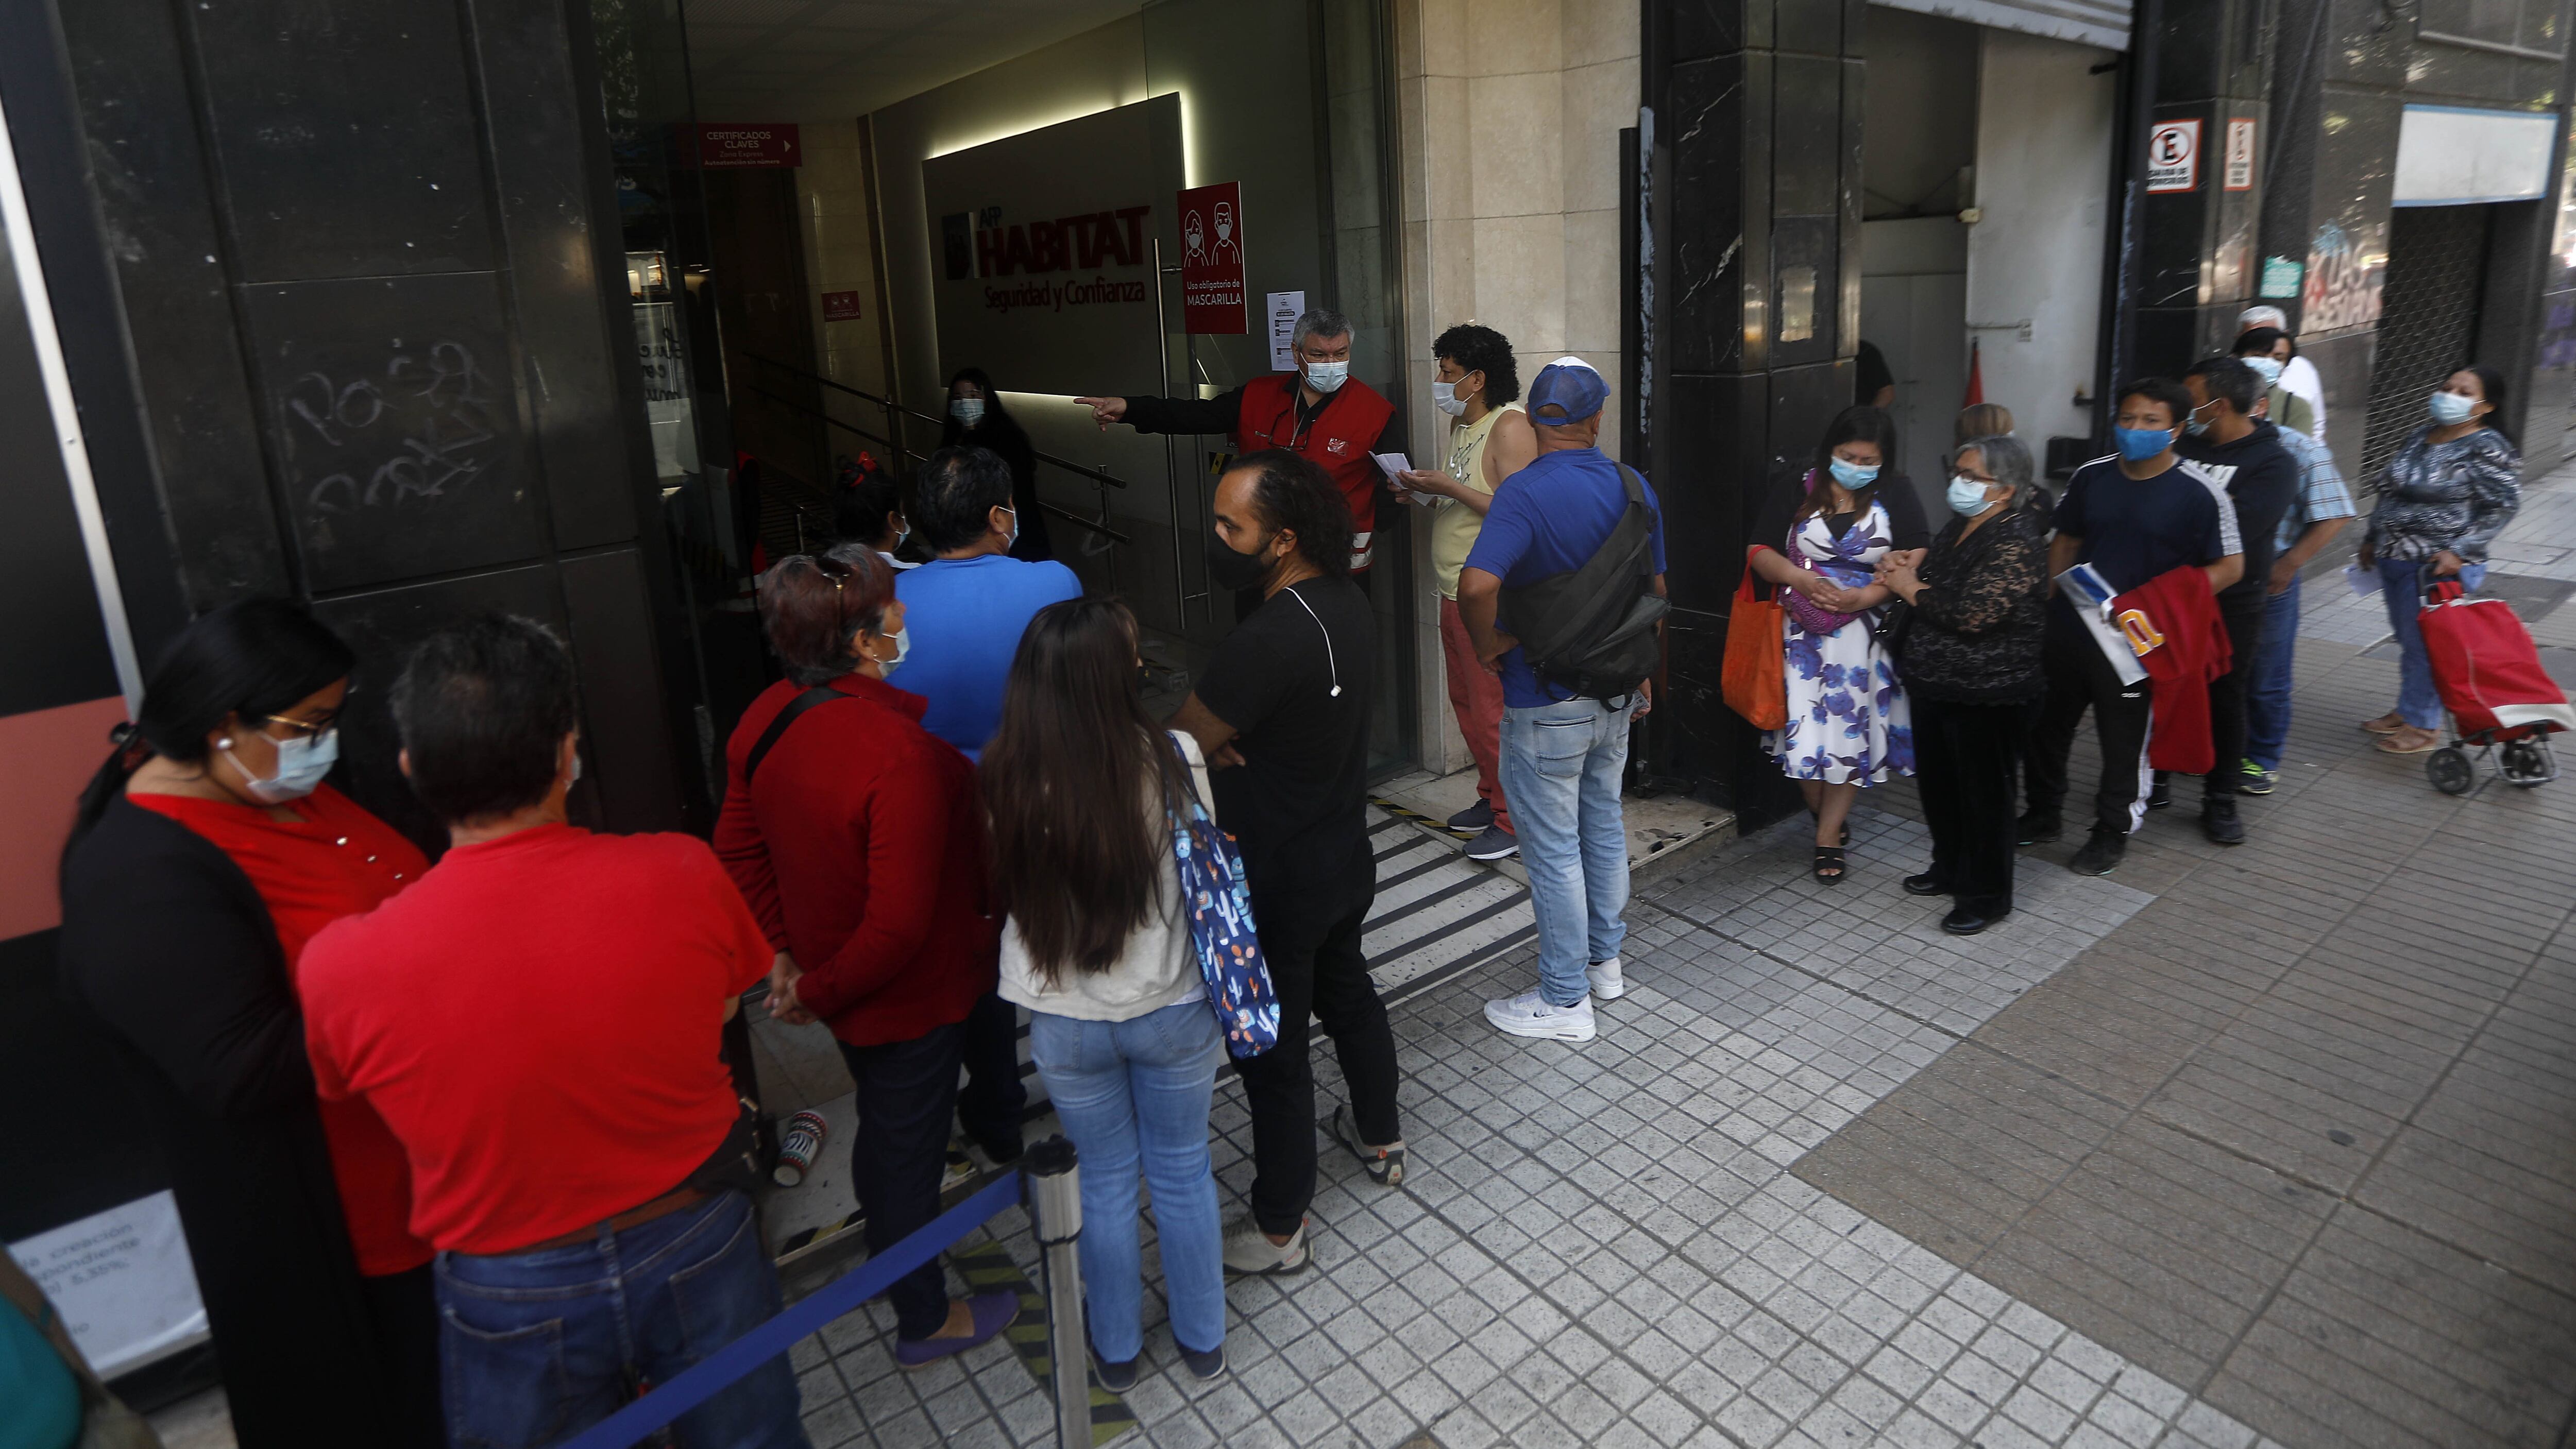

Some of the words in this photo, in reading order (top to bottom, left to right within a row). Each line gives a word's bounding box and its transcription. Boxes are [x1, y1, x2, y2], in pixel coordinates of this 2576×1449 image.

[706, 131, 771, 140] CERTIFICADOS
[724, 140, 759, 149] CLAVES
[2162, 133, 2177, 161] E
[979, 206, 1002, 229] AFP
[976, 206, 1151, 278] HABITAT
[1187, 281, 1198, 290] Uso
[1198, 279, 1231, 291] obligatorio
[1232, 277, 1241, 287] de
[985, 280, 1050, 314] Seguridad
[1054, 288, 1063, 312] y
[1065, 276, 1145, 305] Confianza
[1187, 292, 1243, 306] MASCARILLA
